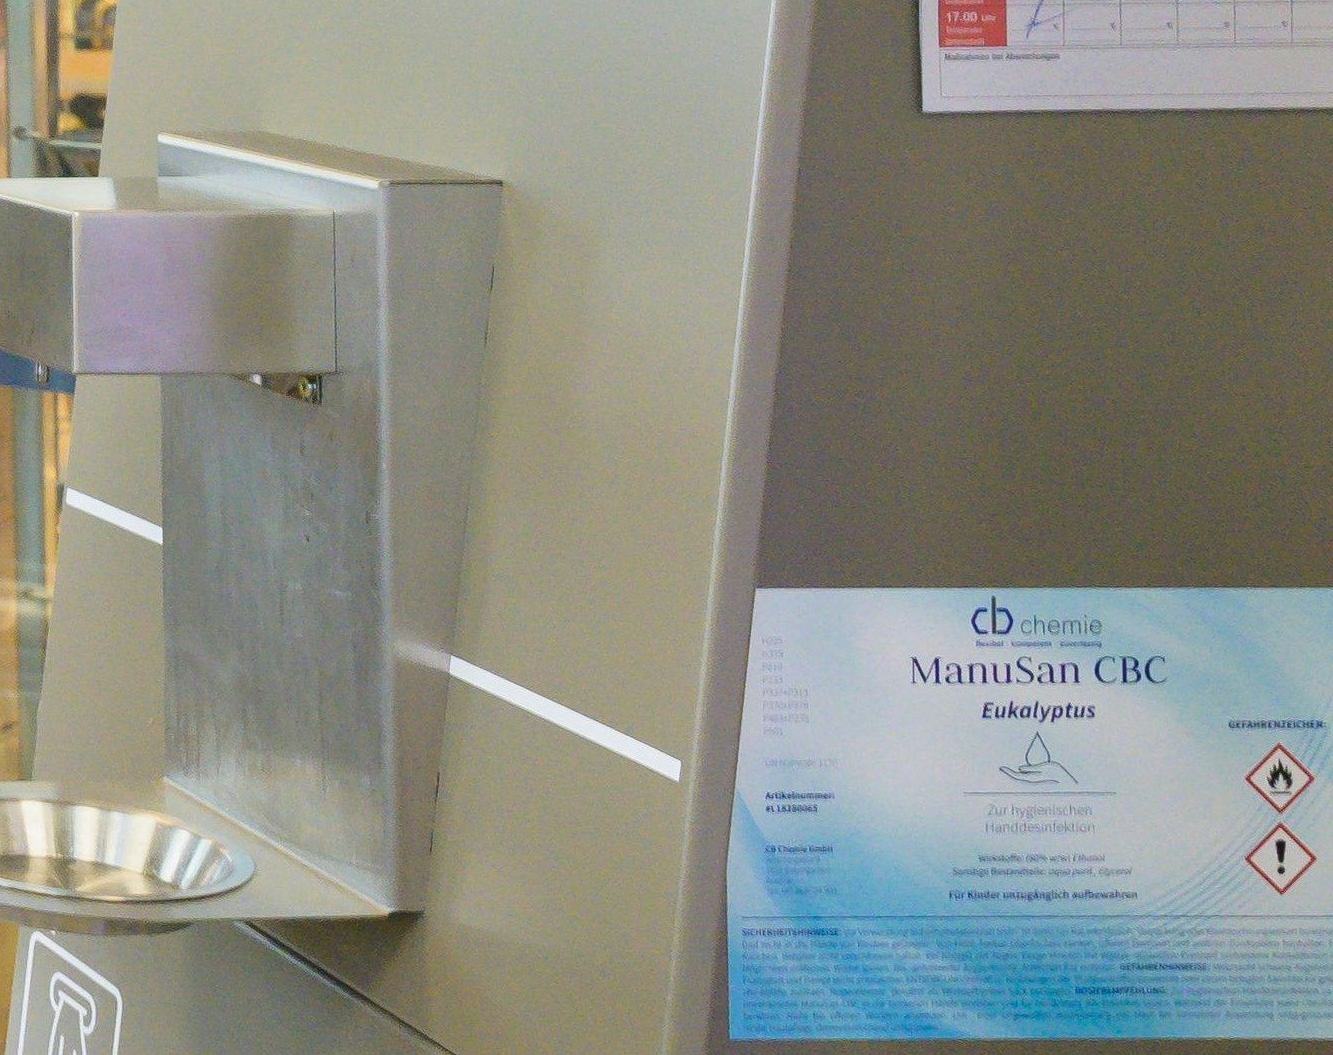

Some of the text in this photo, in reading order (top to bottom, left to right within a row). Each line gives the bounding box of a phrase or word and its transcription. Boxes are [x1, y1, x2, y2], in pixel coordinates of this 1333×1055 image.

[945, 11, 978, 22] 17.00
[1020, 614, 1103, 636] chemie
[910, 655, 1169, 685] ManuSan CBC
[981, 700, 1096, 722] Eukalyptus
[987, 803, 1094, 819] Zur hygienischen
[985, 821, 1096, 834] Handdesinfektion
[948, 889, 1138, 902] Für Kinder unzugänglich aufbewahren
